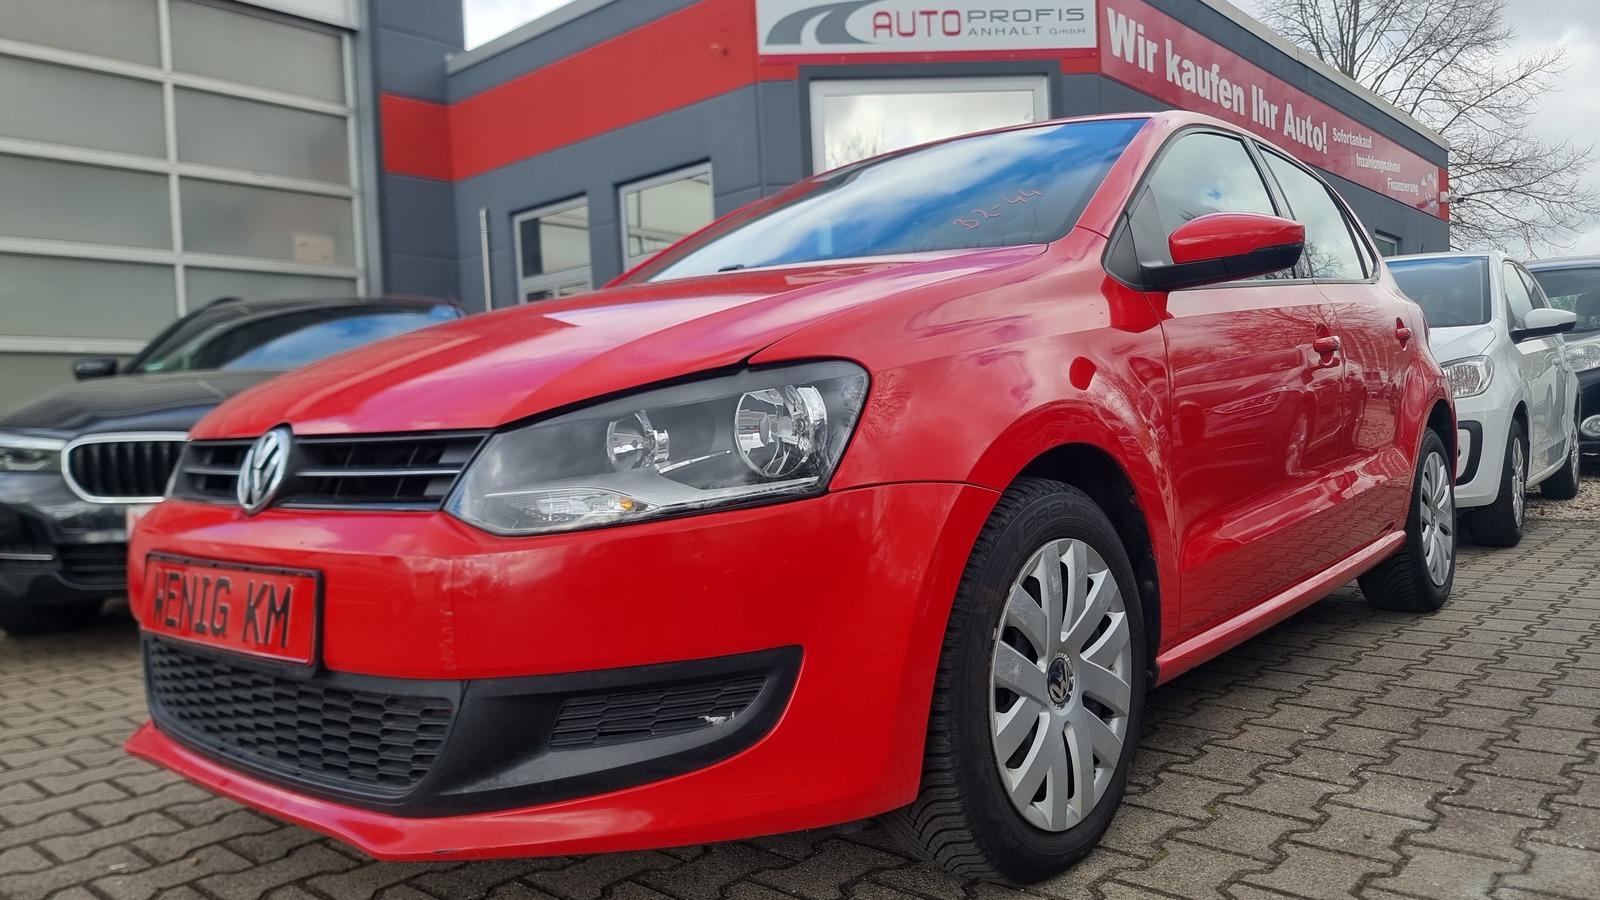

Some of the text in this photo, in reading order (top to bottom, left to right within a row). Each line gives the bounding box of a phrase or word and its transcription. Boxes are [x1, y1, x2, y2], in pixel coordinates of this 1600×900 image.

[873, 8, 1085, 38] AUTO PROFIS
[967, 26, 1043, 36] ANHALT
[1106, 7, 1328, 154] Wir kaufen Ihr Auto!
[1332, 127, 1373, 149] Sofortankauf
[1355, 153, 1401, 174] Inzahlungnahme
[1386, 177, 1419, 196] Finanzierung
[154, 568, 294, 649] WENIG KM
